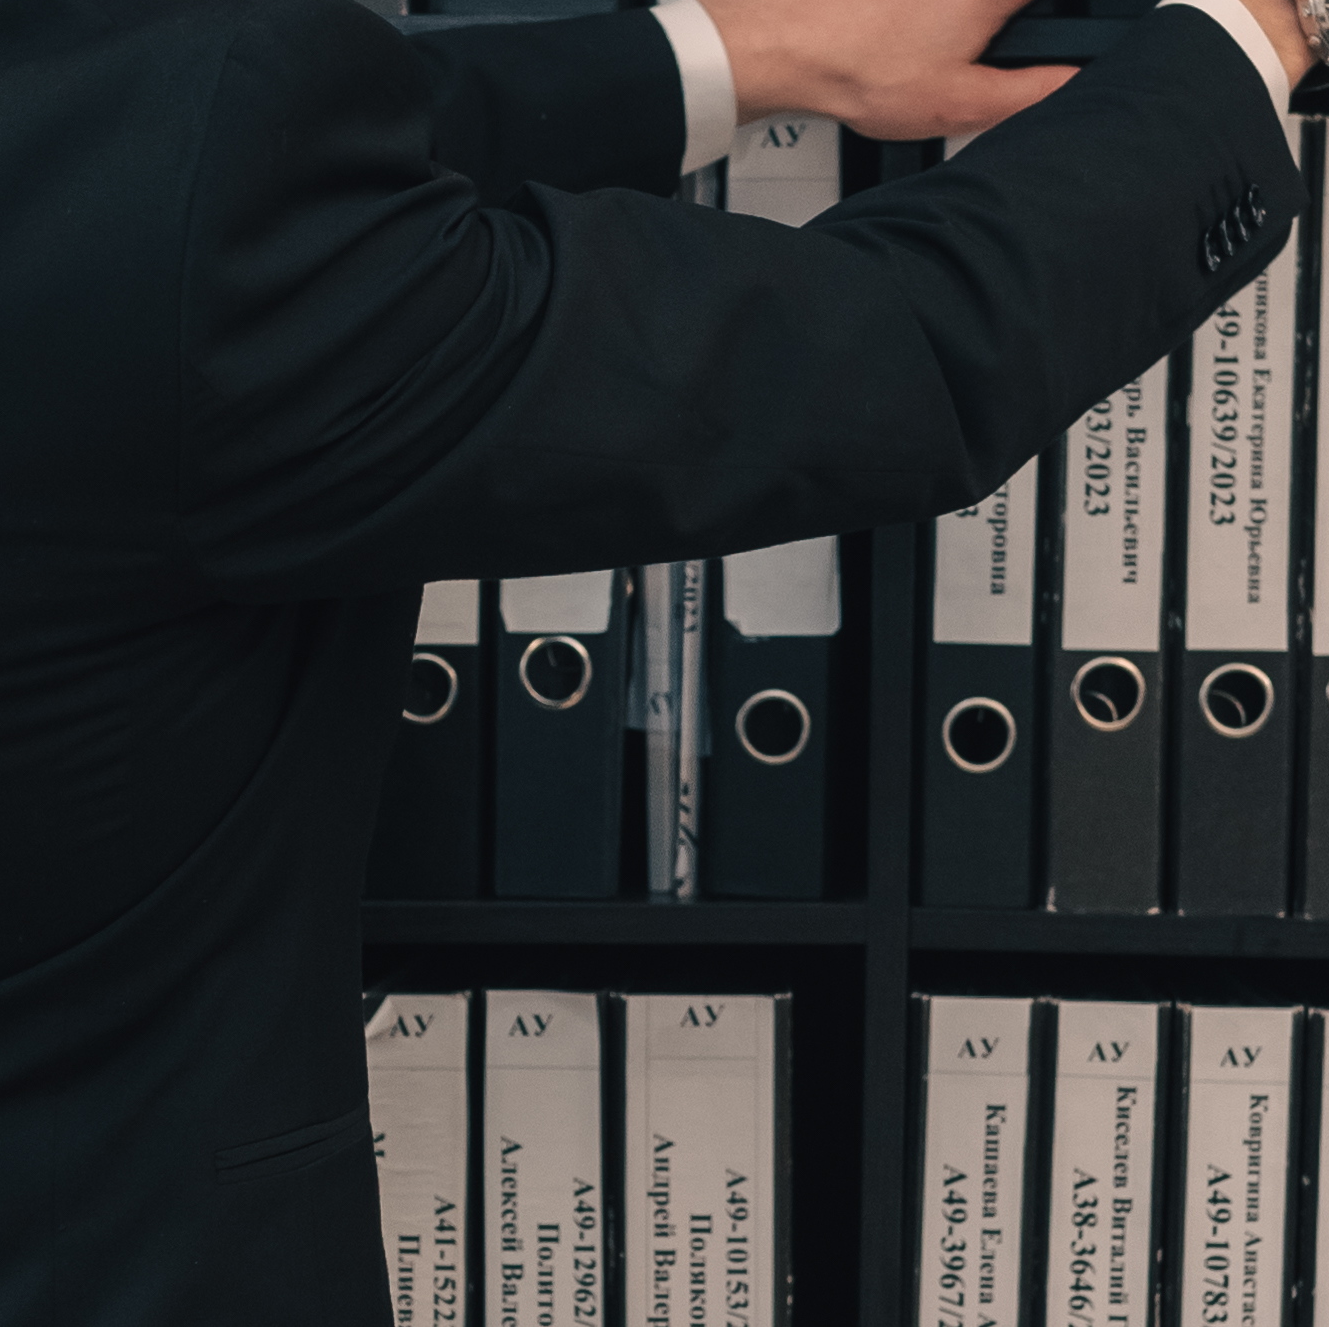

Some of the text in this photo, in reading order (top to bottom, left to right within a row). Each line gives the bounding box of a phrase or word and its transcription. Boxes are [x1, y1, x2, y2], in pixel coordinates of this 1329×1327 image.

[389, 1013, 435, 1040] АУ
[507, 1012, 554, 1039] АУ
[679, 1003, 726, 1029] АУ
[957, 1036, 999, 1060] АУ
[1087, 1040, 1130, 1064] АУ
[1220, 1044, 1263, 1069] АУ
[1238, 1094, 1270, 1223] Ковригина
[500, 1136, 524, 1253] Алексей
[649, 1133, 676, 1238] Андрей
[1107, 1086, 1138, 1305] Киселев Виталий
[978, 1103, 1008, 1305] Кашаева Елена
